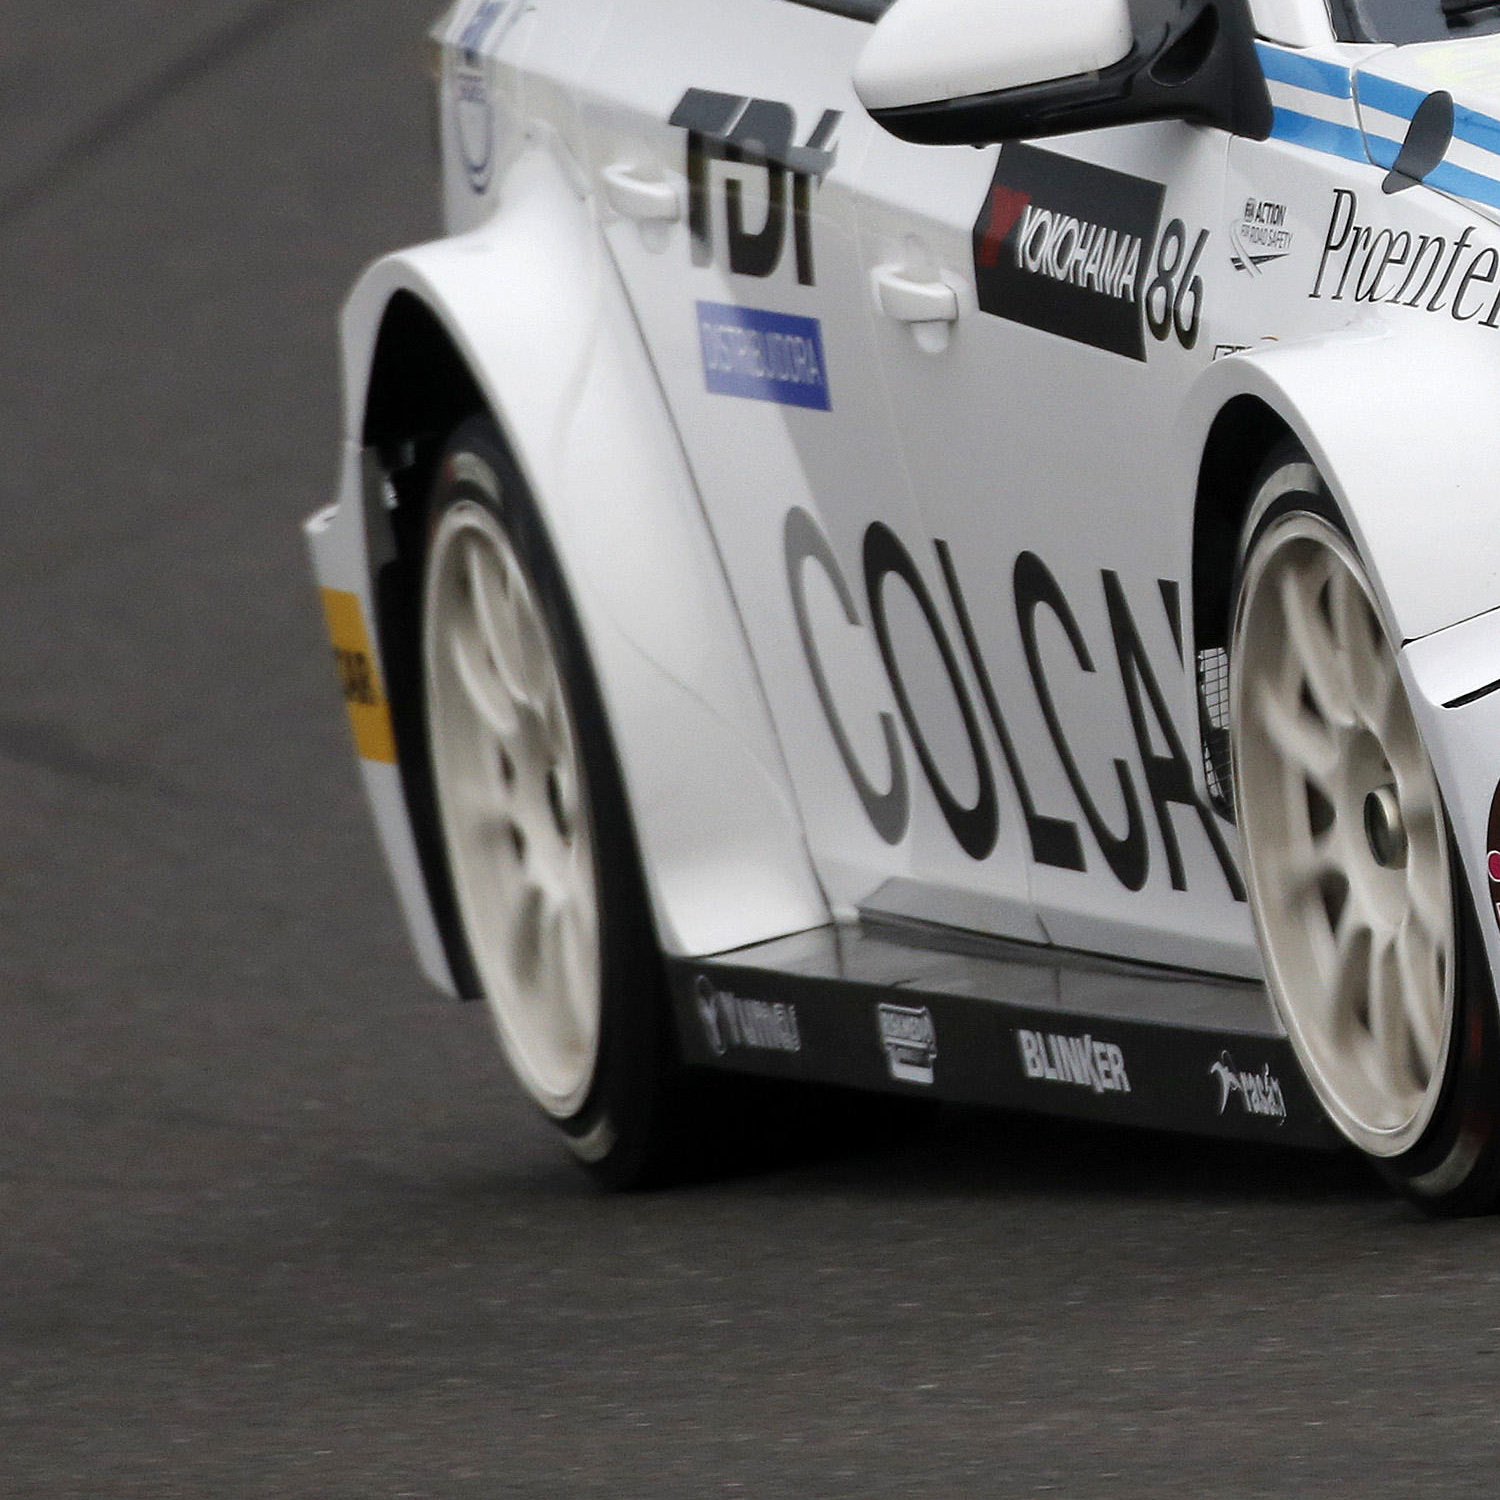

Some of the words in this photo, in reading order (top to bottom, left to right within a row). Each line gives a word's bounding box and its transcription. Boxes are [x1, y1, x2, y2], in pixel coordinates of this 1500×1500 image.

[669, 87, 844, 286] TDI
[1255, 201, 1288, 227] ACTION
[1017, 204, 1142, 303] YOKOHAMA
[1145, 218, 1211, 351] 86
[784, 505, 1249, 904] COLCA
[1018, 1028, 1132, 1094] BLINKER
